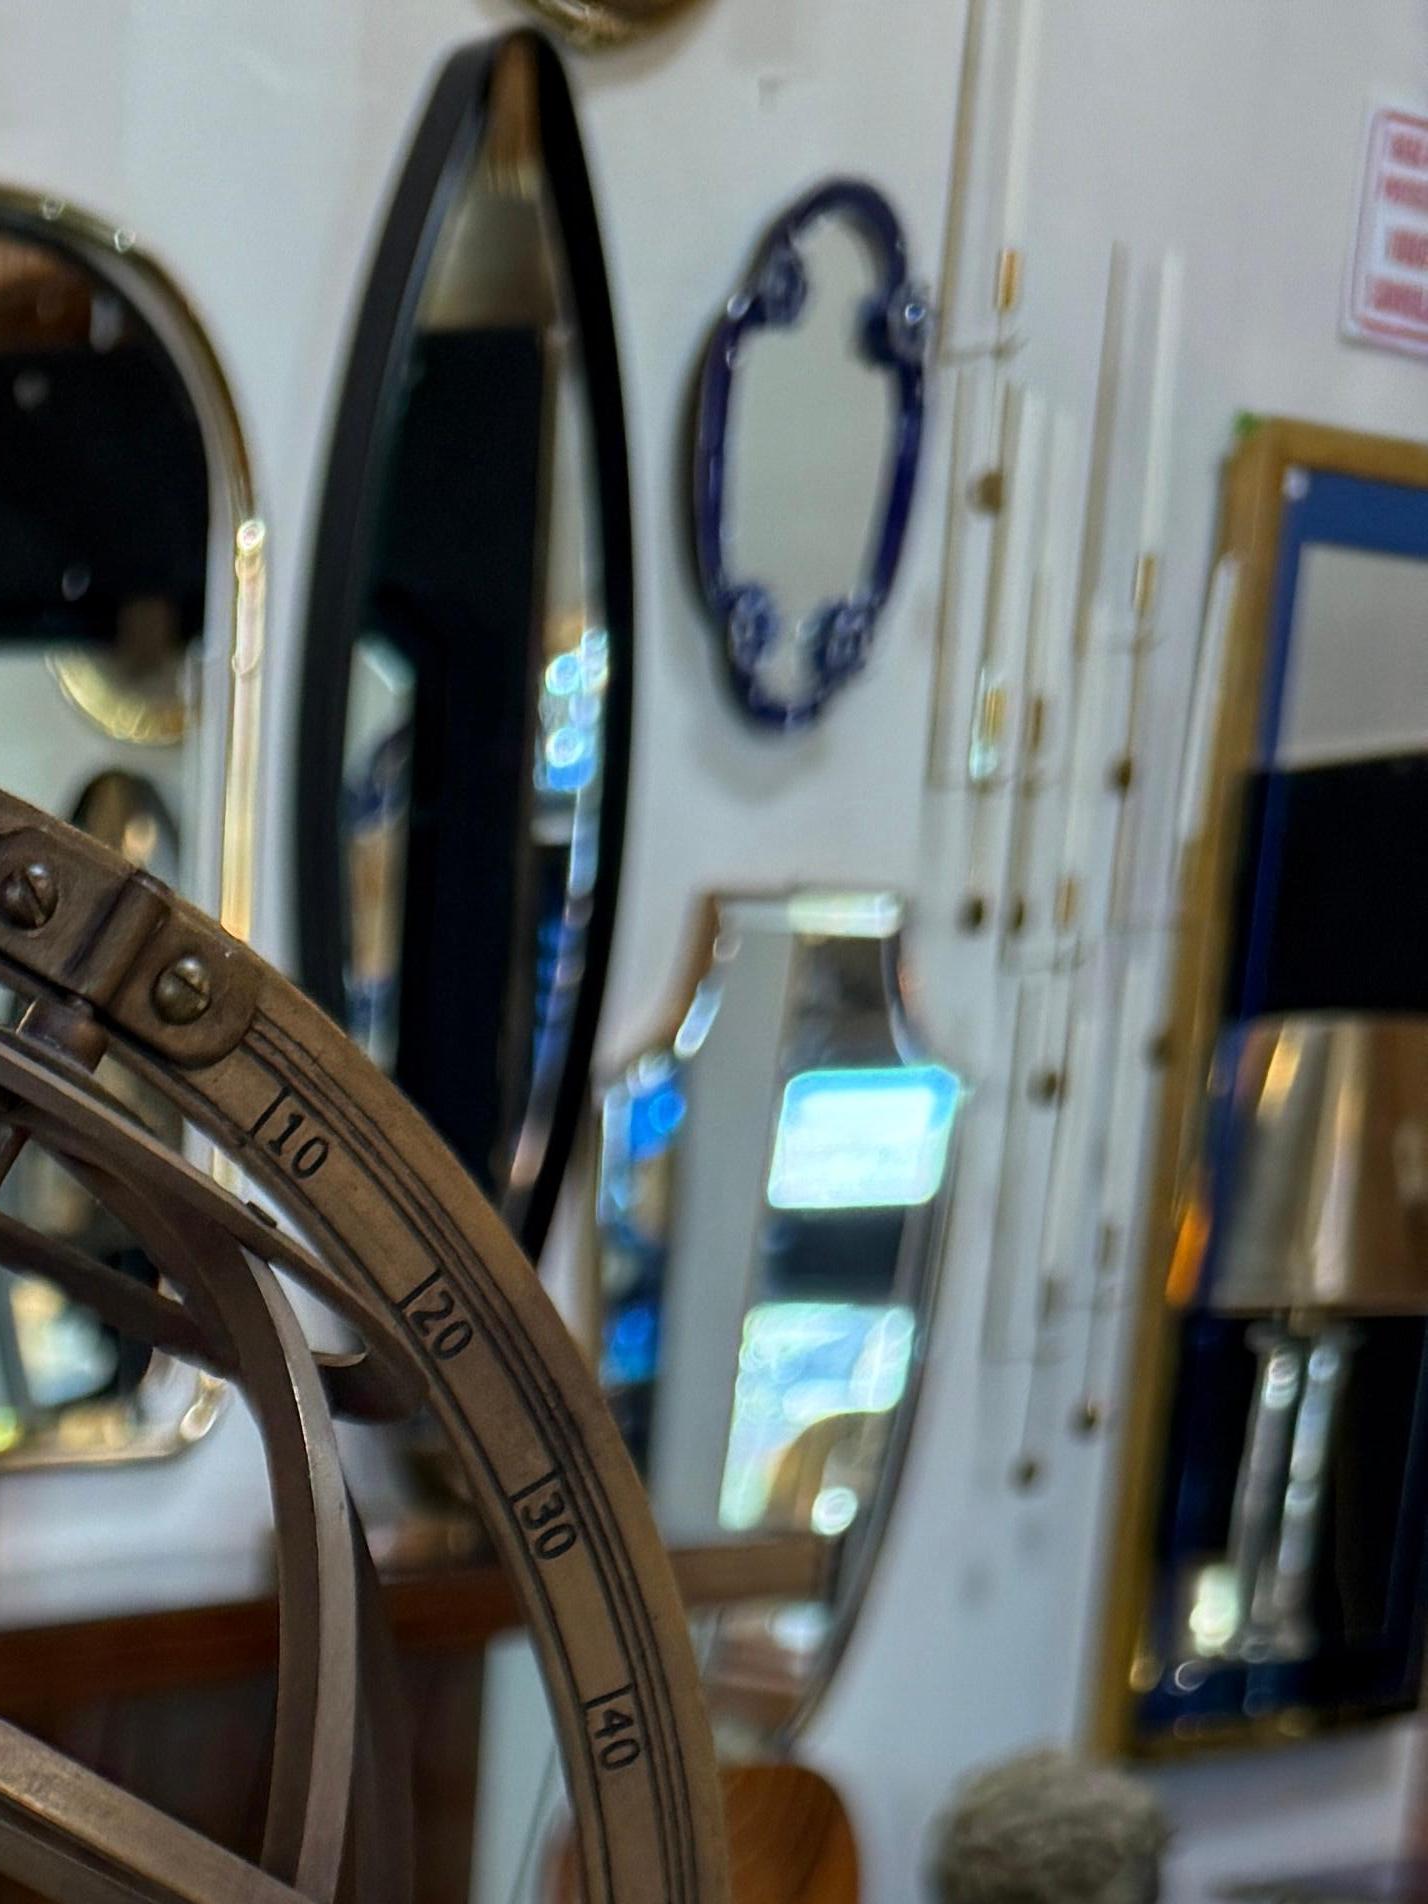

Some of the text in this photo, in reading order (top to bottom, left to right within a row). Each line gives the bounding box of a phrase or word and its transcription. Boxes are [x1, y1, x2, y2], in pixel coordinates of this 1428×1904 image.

[267, 1112, 329, 1180] 10
[414, 1293, 474, 1361] 20
[521, 1497, 578, 1561] 30
[591, 1705, 641, 1770] 40
